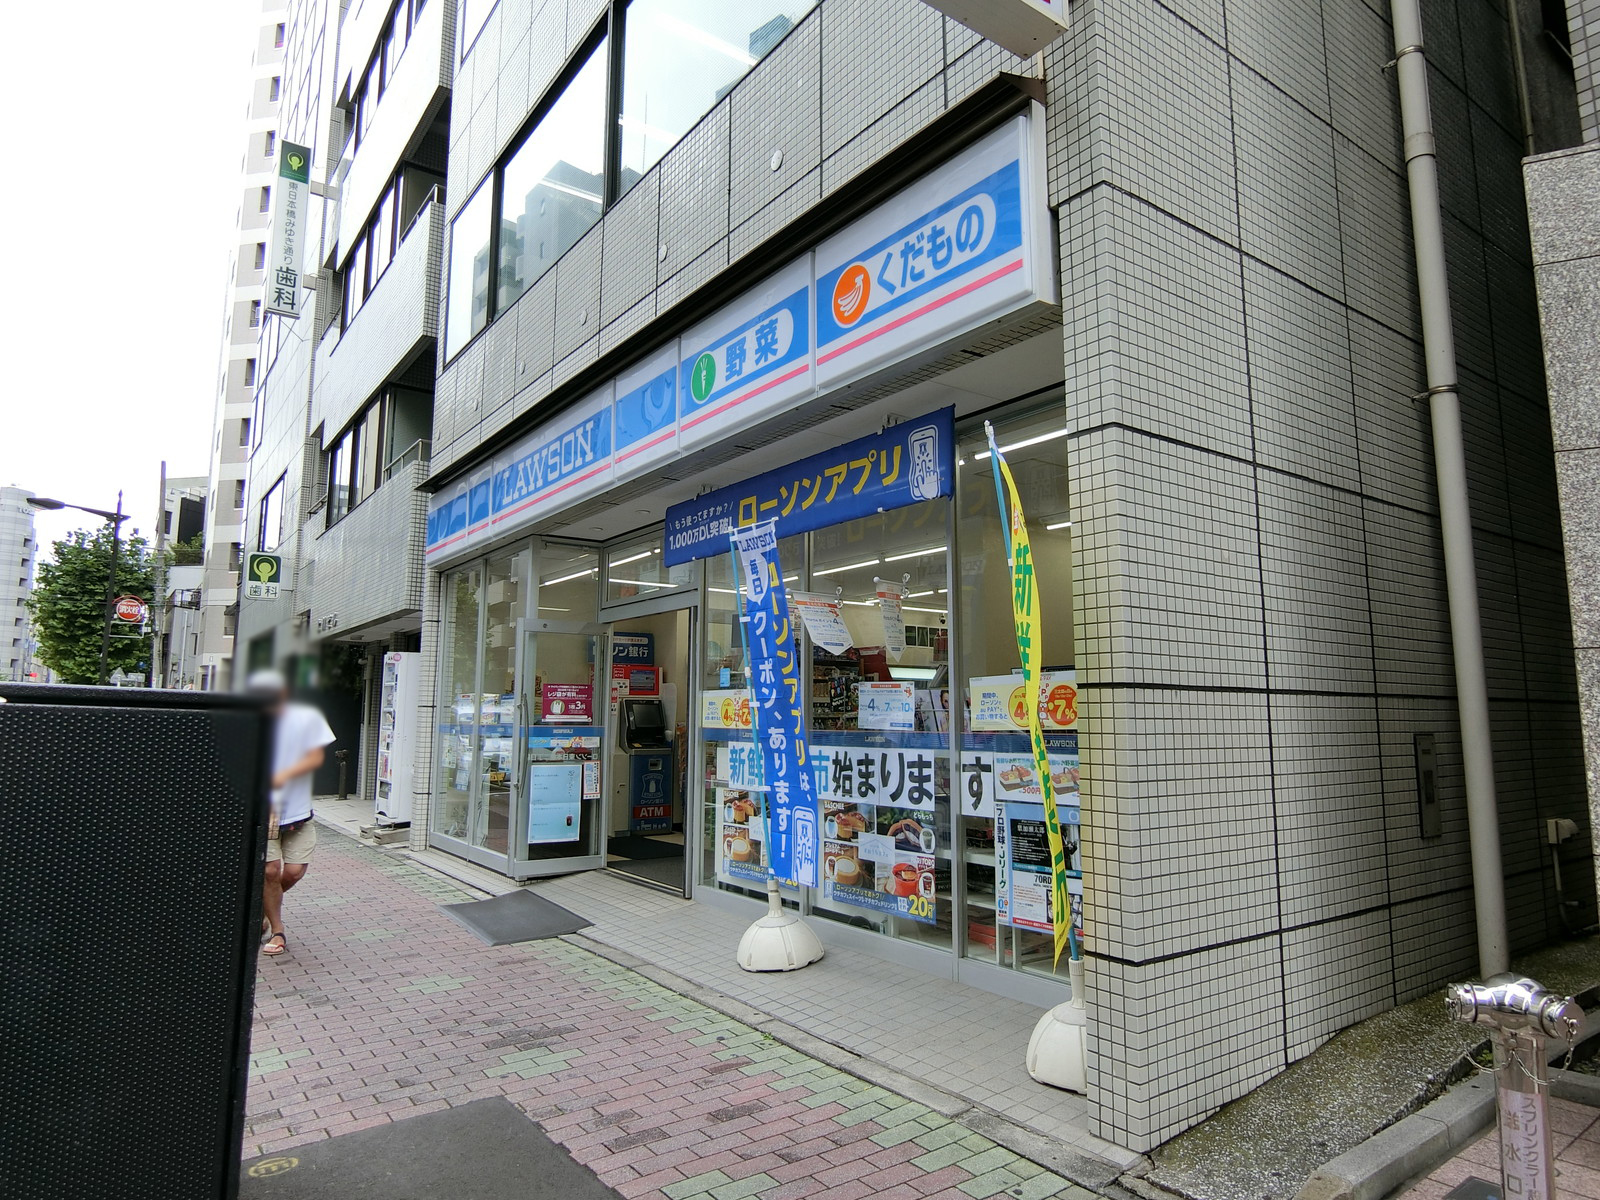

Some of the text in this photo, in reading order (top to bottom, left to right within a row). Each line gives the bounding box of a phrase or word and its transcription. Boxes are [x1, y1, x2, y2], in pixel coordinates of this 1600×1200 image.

[876, 204, 985, 296] くだもの
[273, 265, 298, 311] 歯科
[724, 316, 780, 383] 野菜
[502, 420, 596, 503] LAWSON
[738, 444, 902, 528] ローソンアプリ
[249, 584, 278, 598] 歯科
[639, 806, 664, 818] ATM
